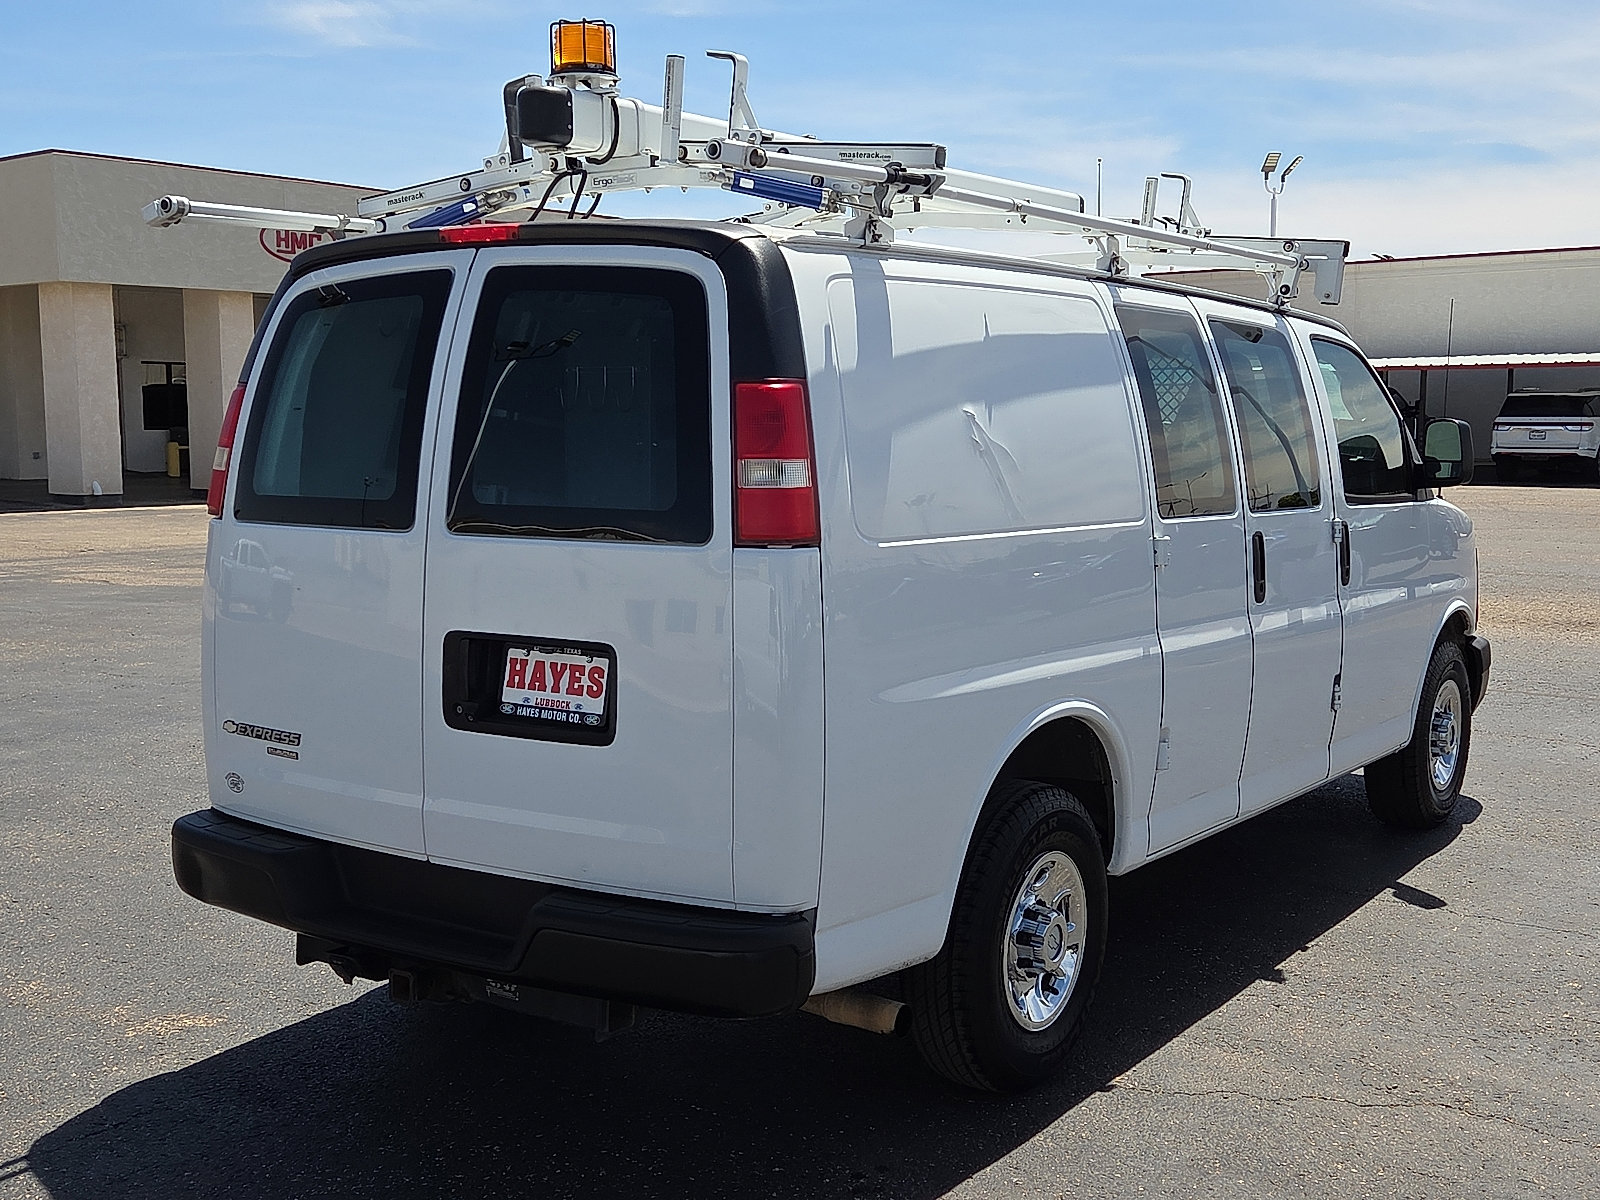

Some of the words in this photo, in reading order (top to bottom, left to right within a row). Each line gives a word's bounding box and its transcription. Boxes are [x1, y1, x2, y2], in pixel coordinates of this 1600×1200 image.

[387, 191, 424, 206] masterack
[563, 647, 582, 655] TEXAS
[506, 657, 605, 699] HAYES
[535, 697, 571, 709] LUBBOCK
[516, 706, 539, 718] HAYES
[541, 709, 567, 721] MOTOR
[569, 714, 582, 724] CO.
[237, 723, 300, 745] EXPRESS
